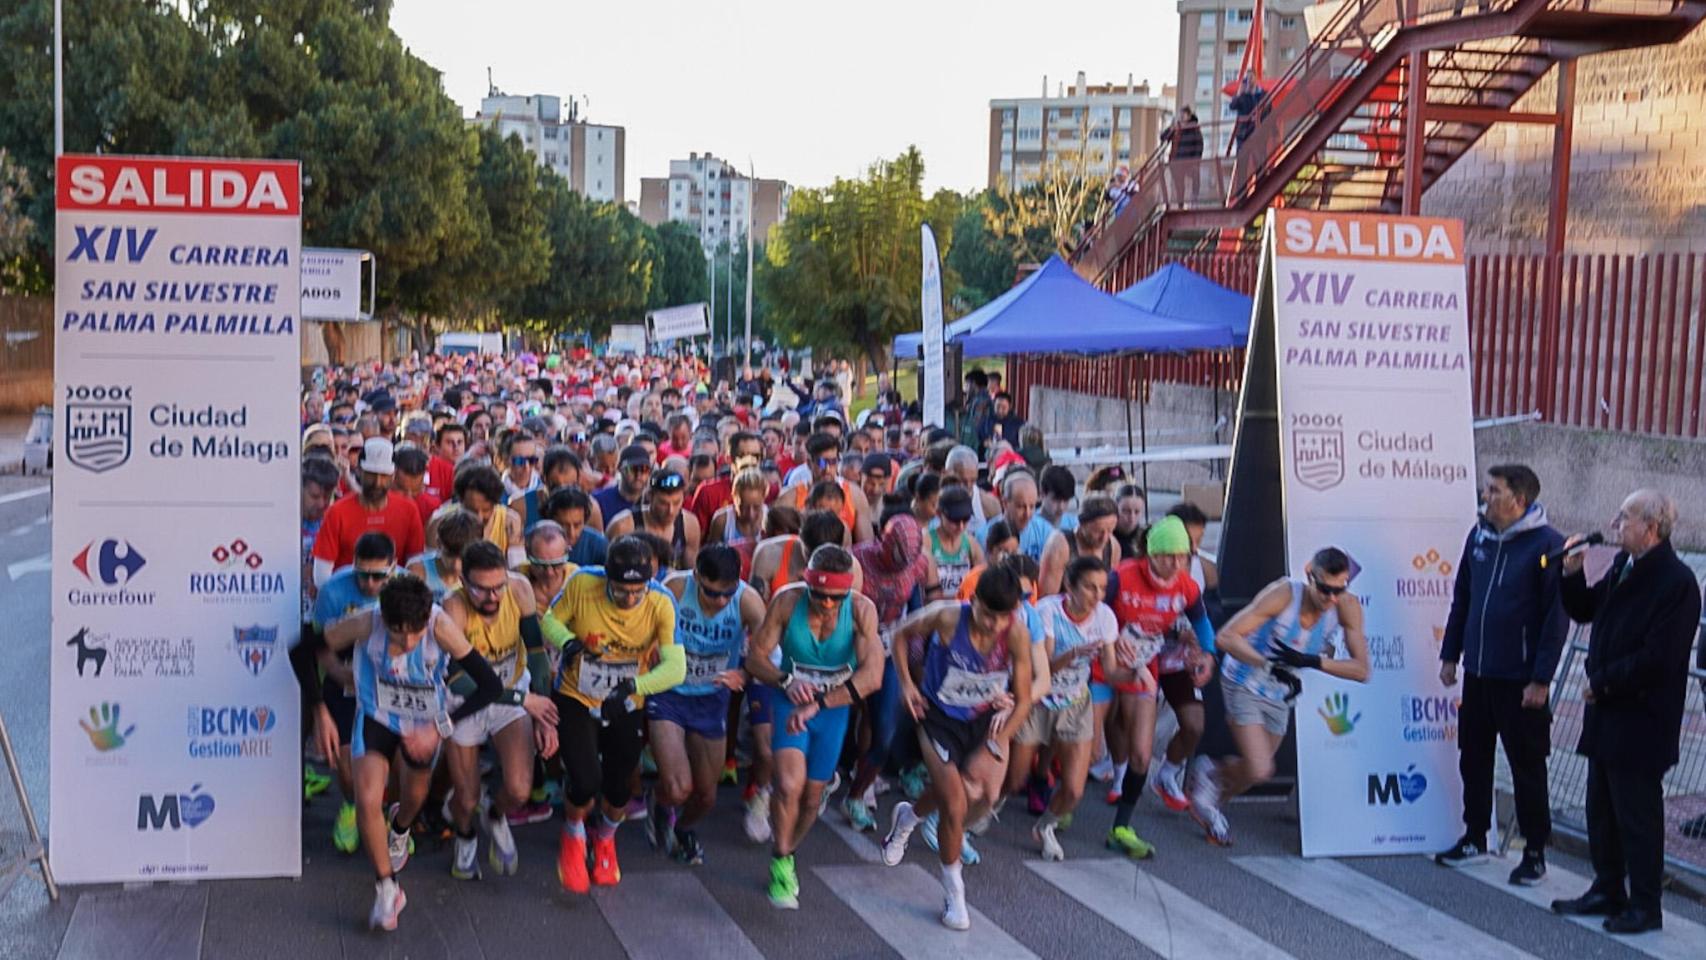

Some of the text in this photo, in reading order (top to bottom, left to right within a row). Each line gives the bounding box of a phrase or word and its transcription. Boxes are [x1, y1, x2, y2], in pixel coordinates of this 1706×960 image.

[69, 165, 289, 210] SALIDA
[66, 225, 289, 267] XIV CARRERA
[1285, 218, 1456, 259] SALIDA
[81, 279, 278, 304] SAN SILVESTRE
[1285, 271, 1458, 310] XIV CARRERA
[62, 311, 294, 335] PALMA PALMILLA
[1298, 319, 1451, 342] SAN SILVESTRE
[1285, 348, 1465, 371] PALMA PALMILLA
[150, 404, 247, 427] Ciudad
[150, 436, 289, 464] de Málaga
[1358, 429, 1433, 451] Ciudad
[1359, 459, 1467, 484] de Málaga
[189, 573, 285, 594] ROSALEDA
[1396, 578, 1455, 598] ROSALE
[68, 588, 156, 606] Carrefour
[391, 693, 427, 711] 225
[1411, 696, 1448, 722] BCM
[201, 707, 248, 736] BCM
